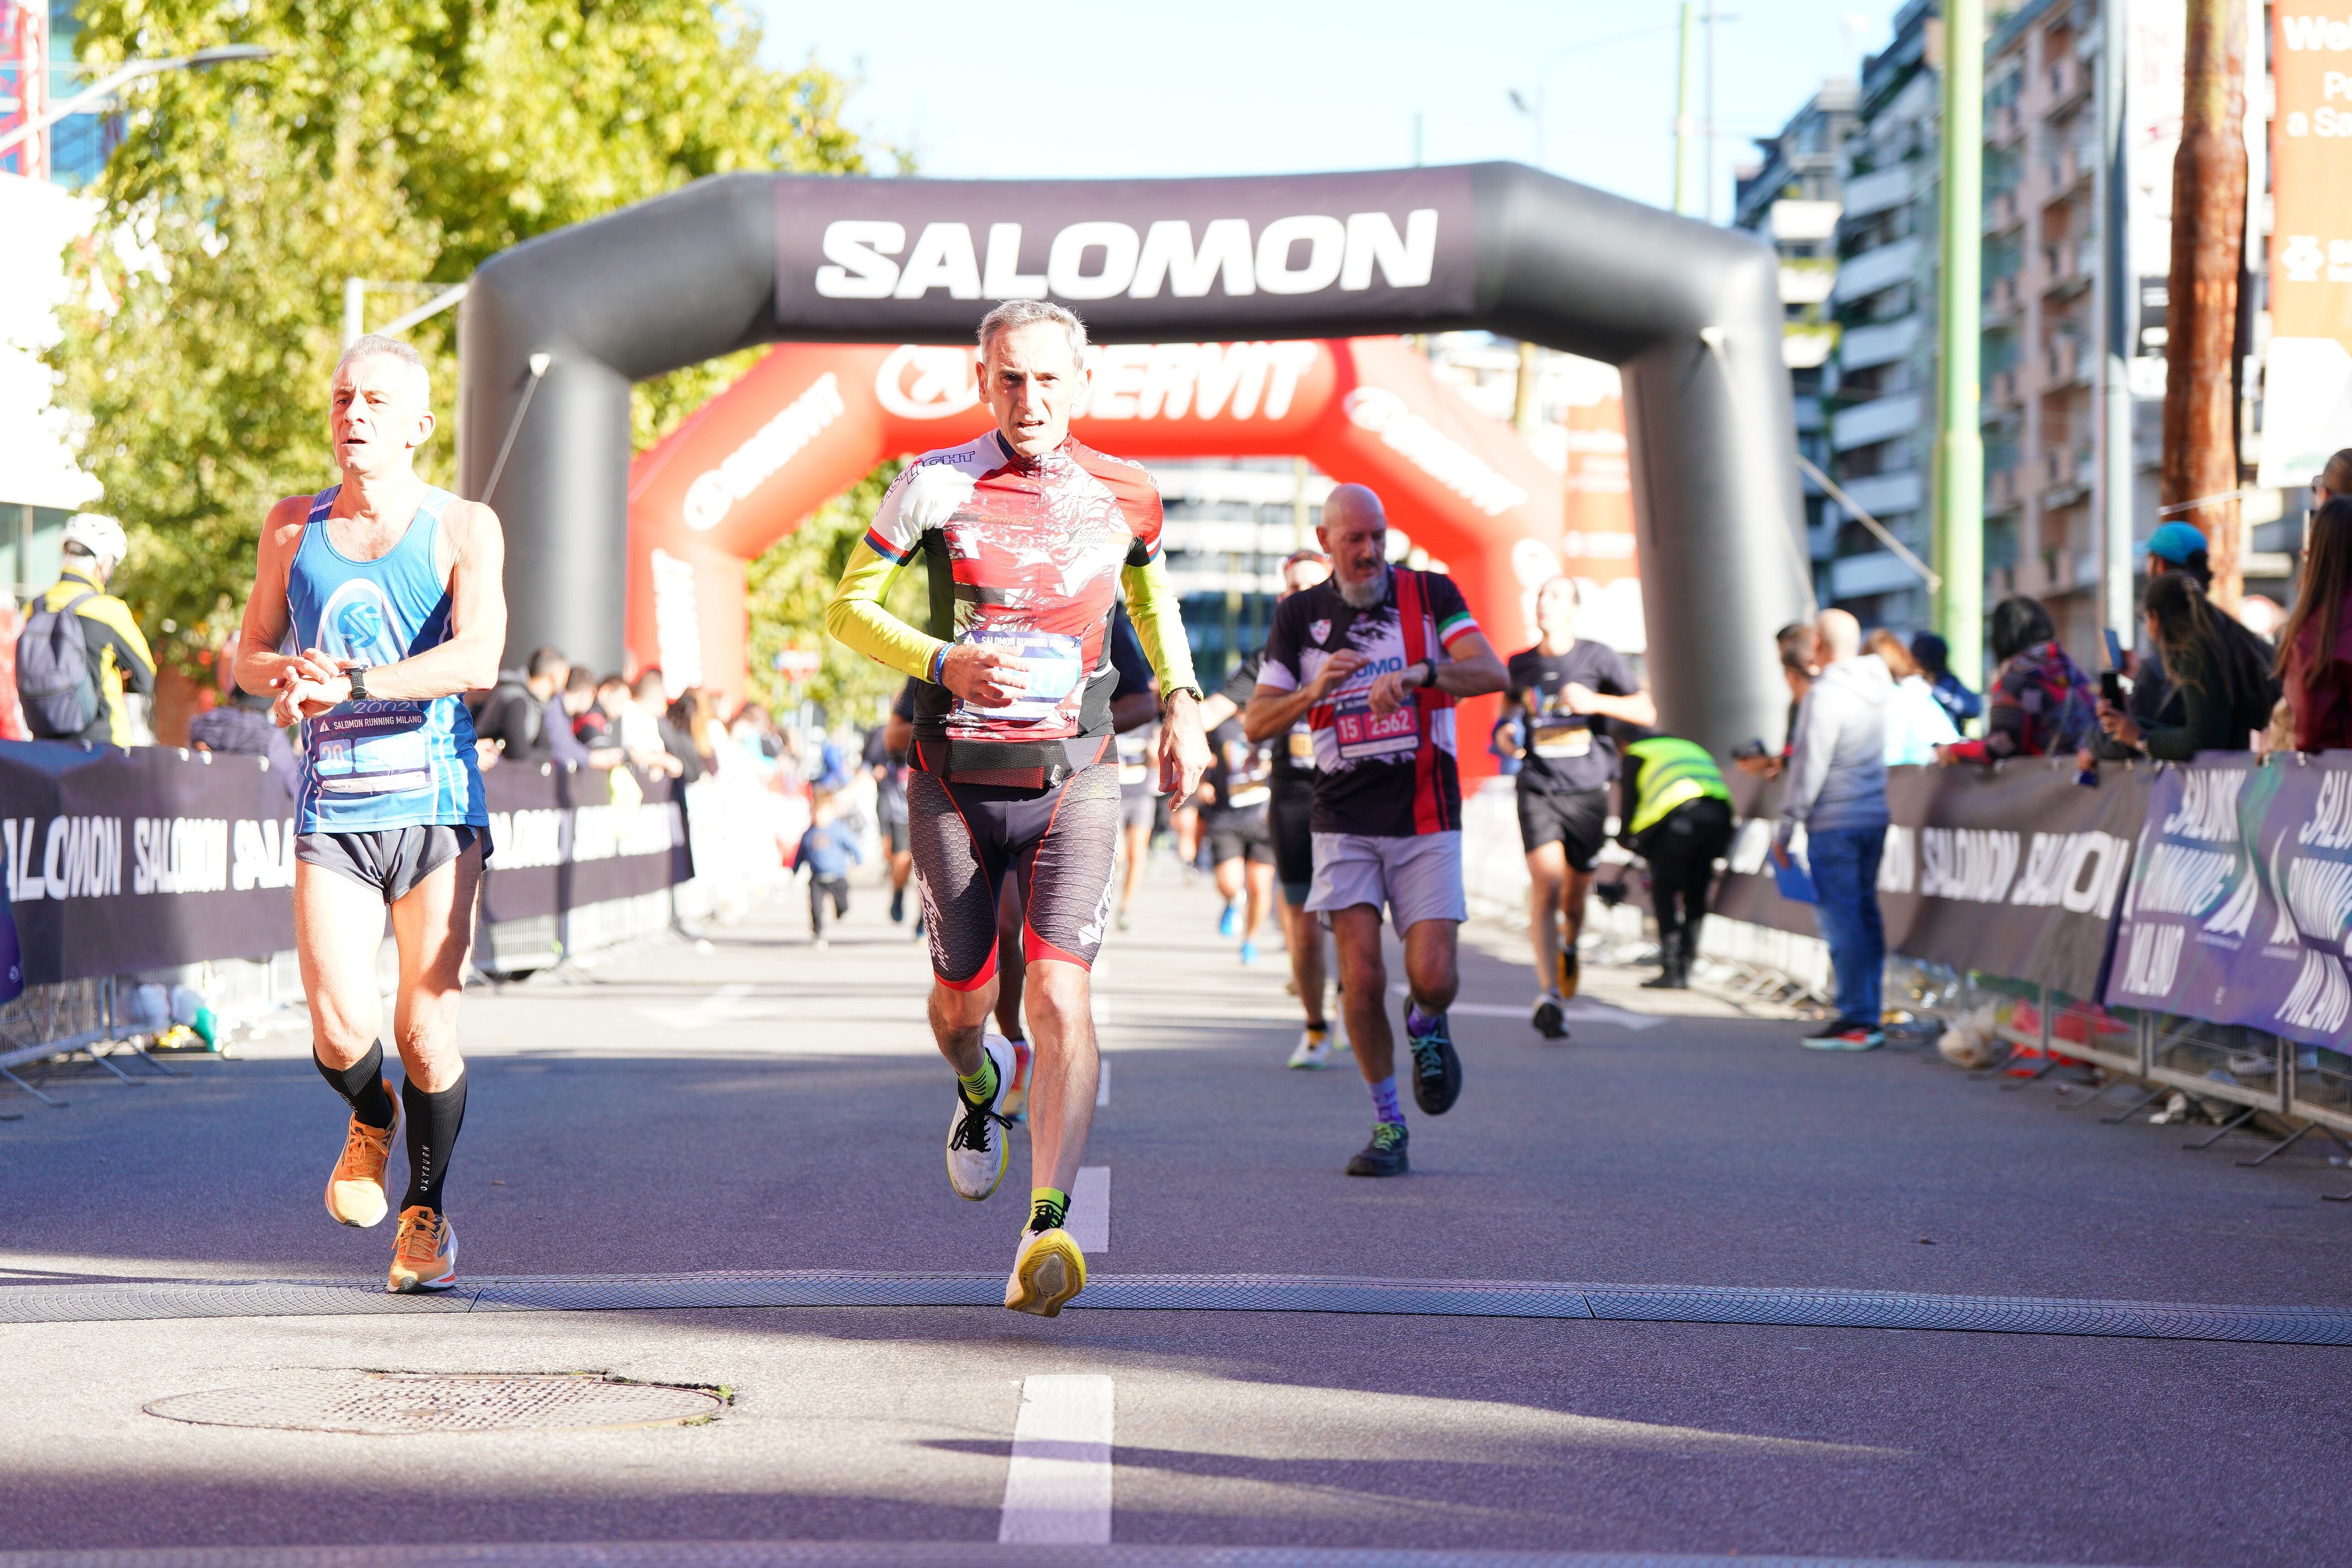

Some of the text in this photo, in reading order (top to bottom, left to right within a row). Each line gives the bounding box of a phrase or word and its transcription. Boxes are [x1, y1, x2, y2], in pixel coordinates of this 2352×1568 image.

[2281, 15, 2352, 51] We
[815, 209, 1439, 300] SALOMON
[981, 636, 1015, 647] SALOMON
[333, 713, 422, 730] SALOMON RUNNING MILANO
[1339, 717, 1358, 739] 15
[321, 744, 345, 770] 20
[420, 1145, 430, 1191] OXYBURN
